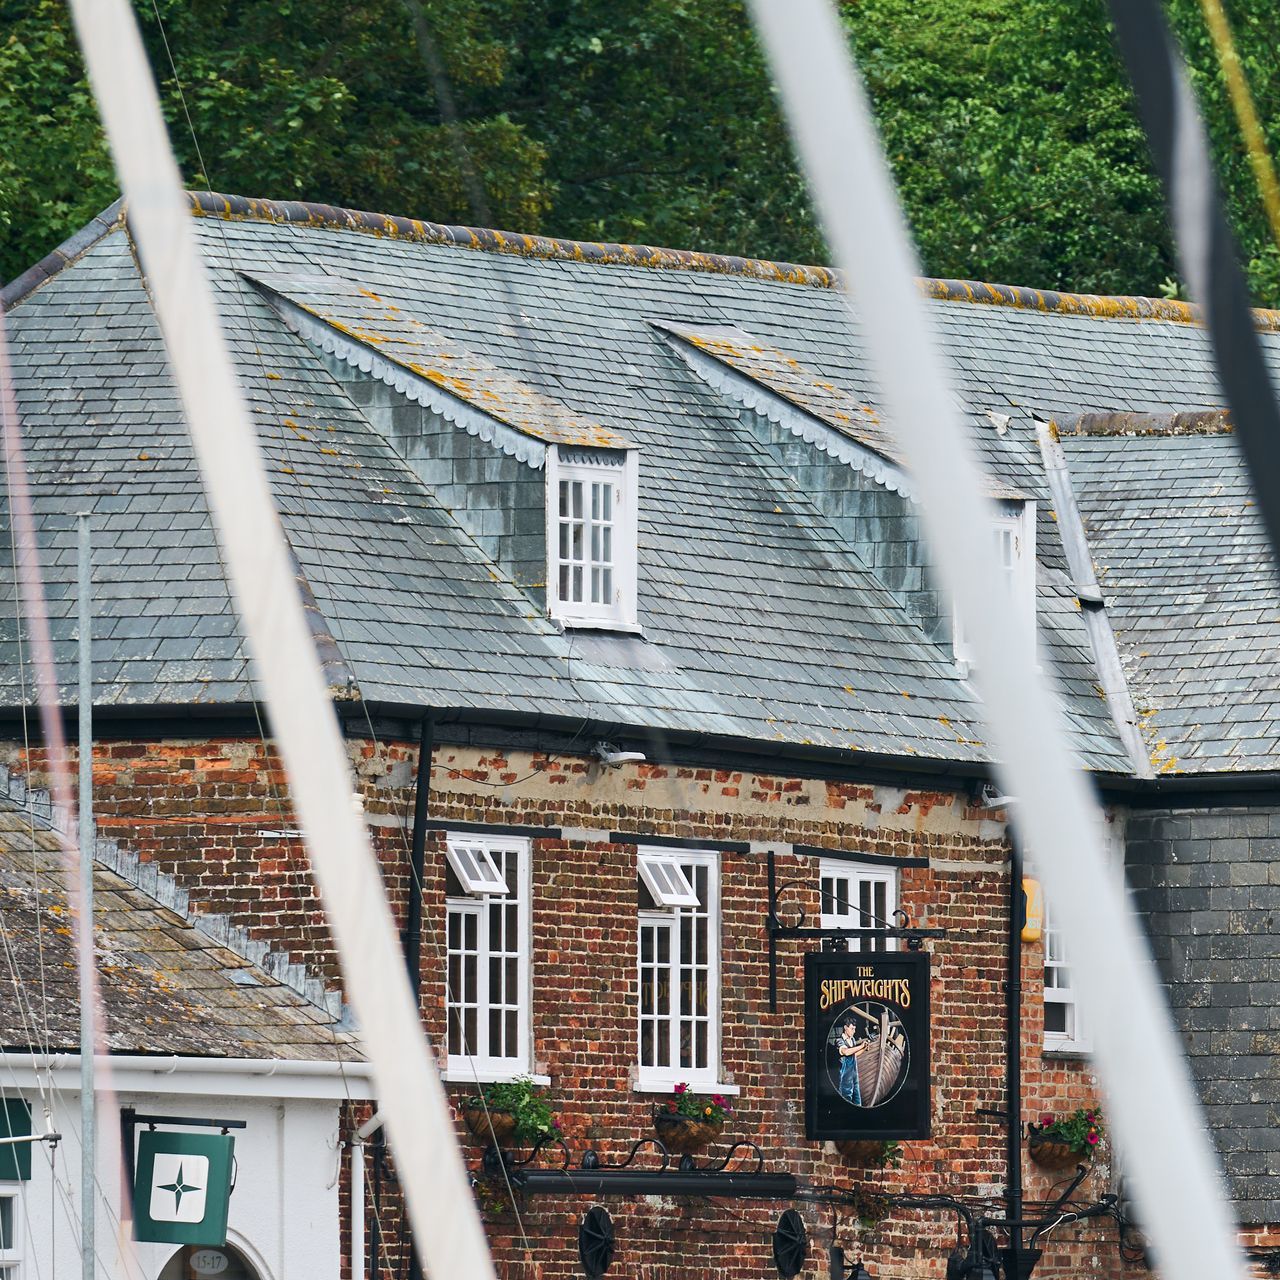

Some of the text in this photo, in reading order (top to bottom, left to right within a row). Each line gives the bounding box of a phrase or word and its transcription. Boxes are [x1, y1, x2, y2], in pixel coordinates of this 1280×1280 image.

[856, 966, 875, 977] THE
[820, 978, 911, 1010] SHIPWRIGHTS
[197, 1255, 222, 1269] 15-17
